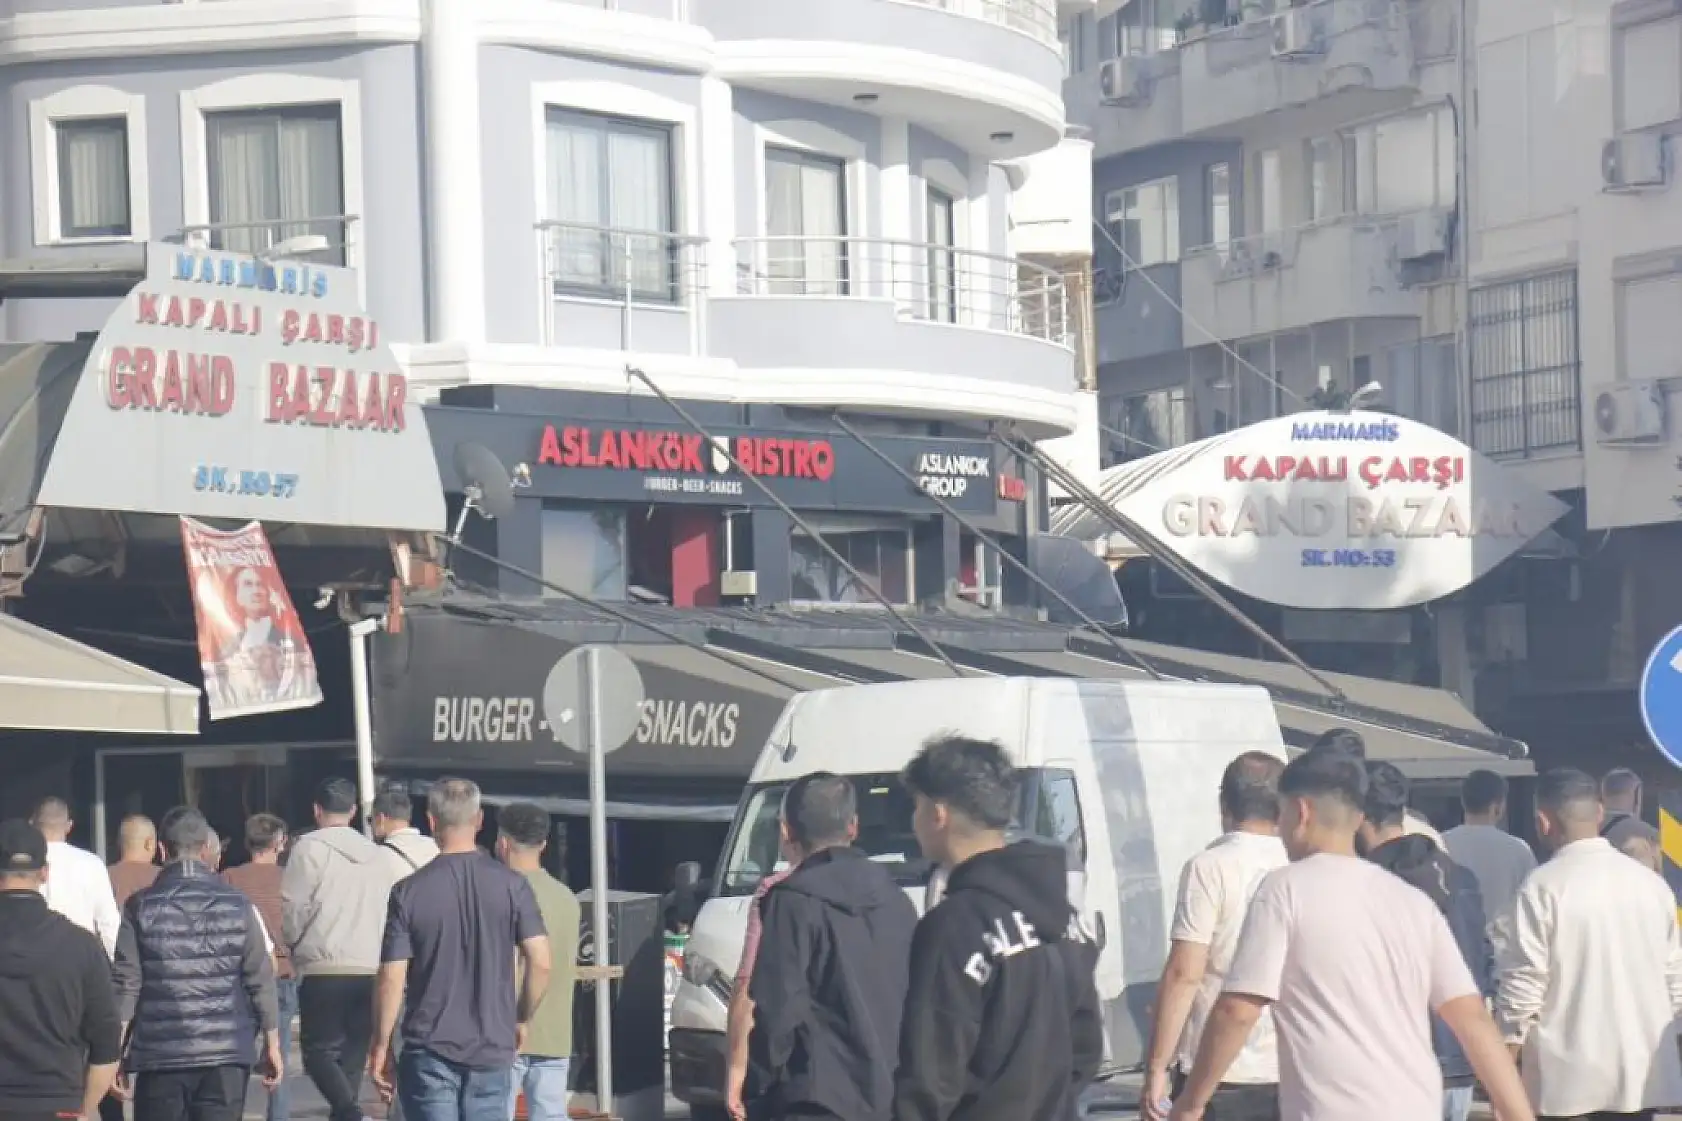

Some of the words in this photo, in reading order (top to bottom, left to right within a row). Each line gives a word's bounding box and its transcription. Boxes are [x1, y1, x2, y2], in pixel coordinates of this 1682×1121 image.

[136, 292, 262, 336] KAPALI
[281, 308, 379, 353] ÇARŞI
[106, 345, 236, 417] GRAND
[264, 361, 408, 433] BAZAAR
[736, 437, 835, 482] BISTRO
[1224, 456, 1348, 482] KAPALI
[1358, 456, 1465, 490] ÇARŞI
[919, 476, 967, 498] GROUP
[1162, 495, 1337, 537] GRAND
[1346, 496, 1530, 538] BAZAAR
[635, 699, 740, 748] SNACKS
